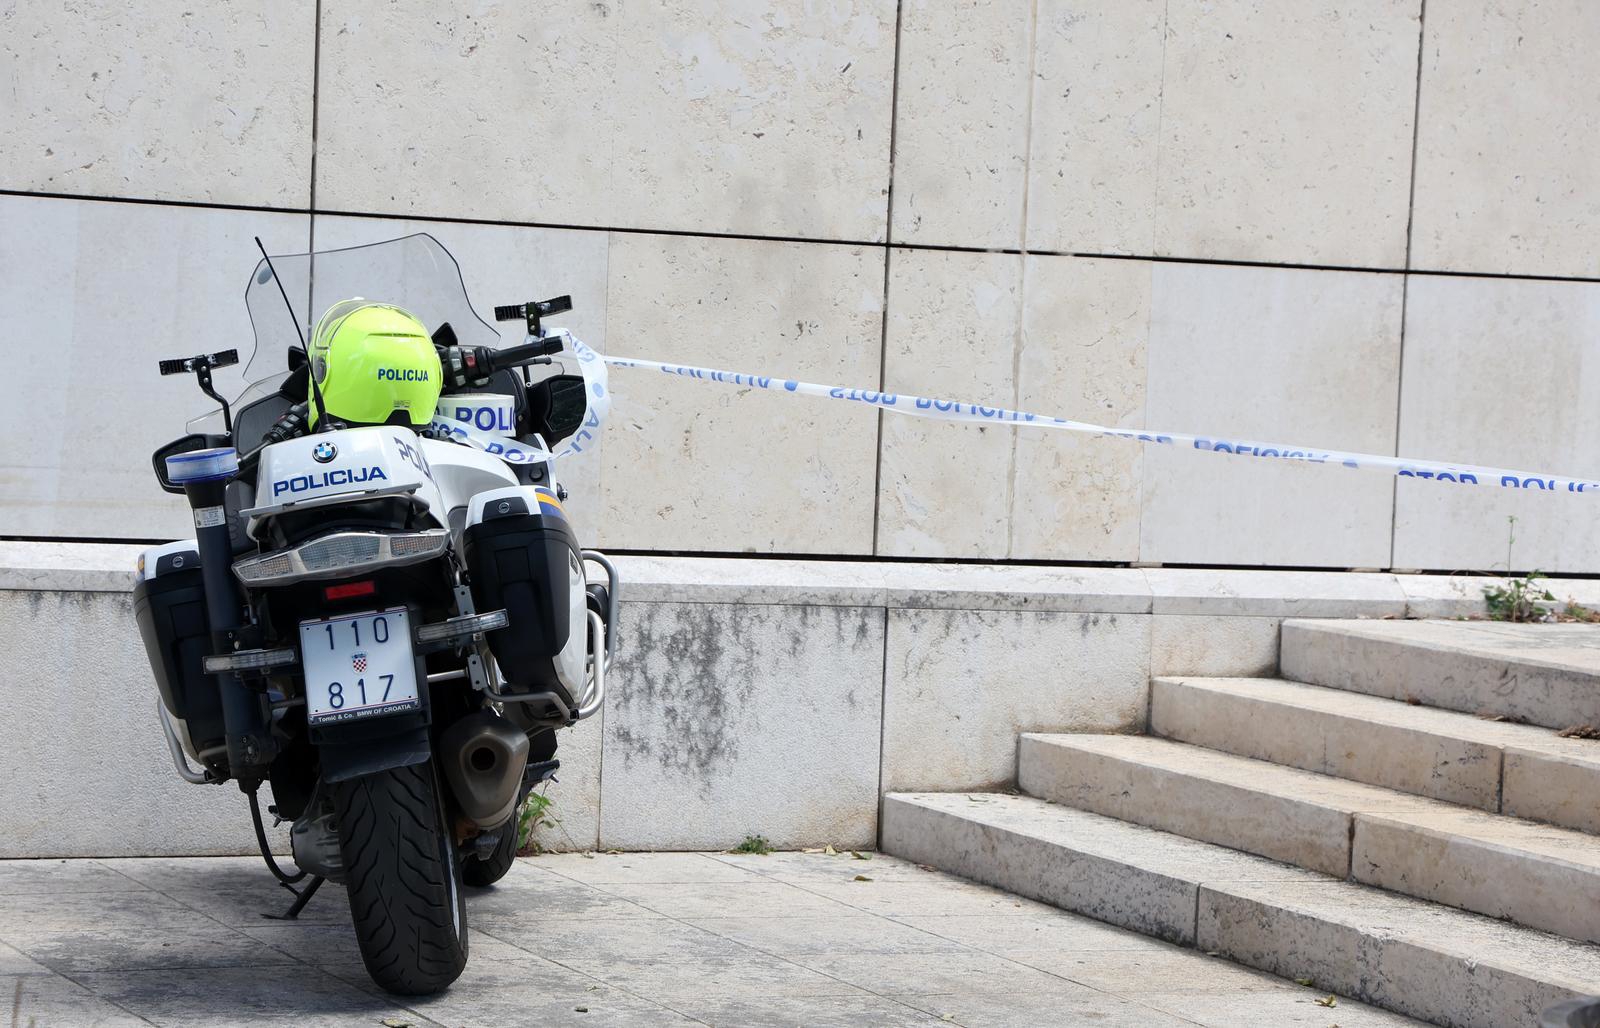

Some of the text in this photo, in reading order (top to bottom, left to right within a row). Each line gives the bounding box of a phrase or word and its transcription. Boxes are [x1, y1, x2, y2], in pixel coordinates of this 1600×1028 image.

[377, 368, 429, 382] POLICIJA
[273, 466, 387, 497] POLICIJA
[325, 616, 389, 650] 110
[328, 674, 394, 709] 817
[383, 704, 411, 713] CROATIA
